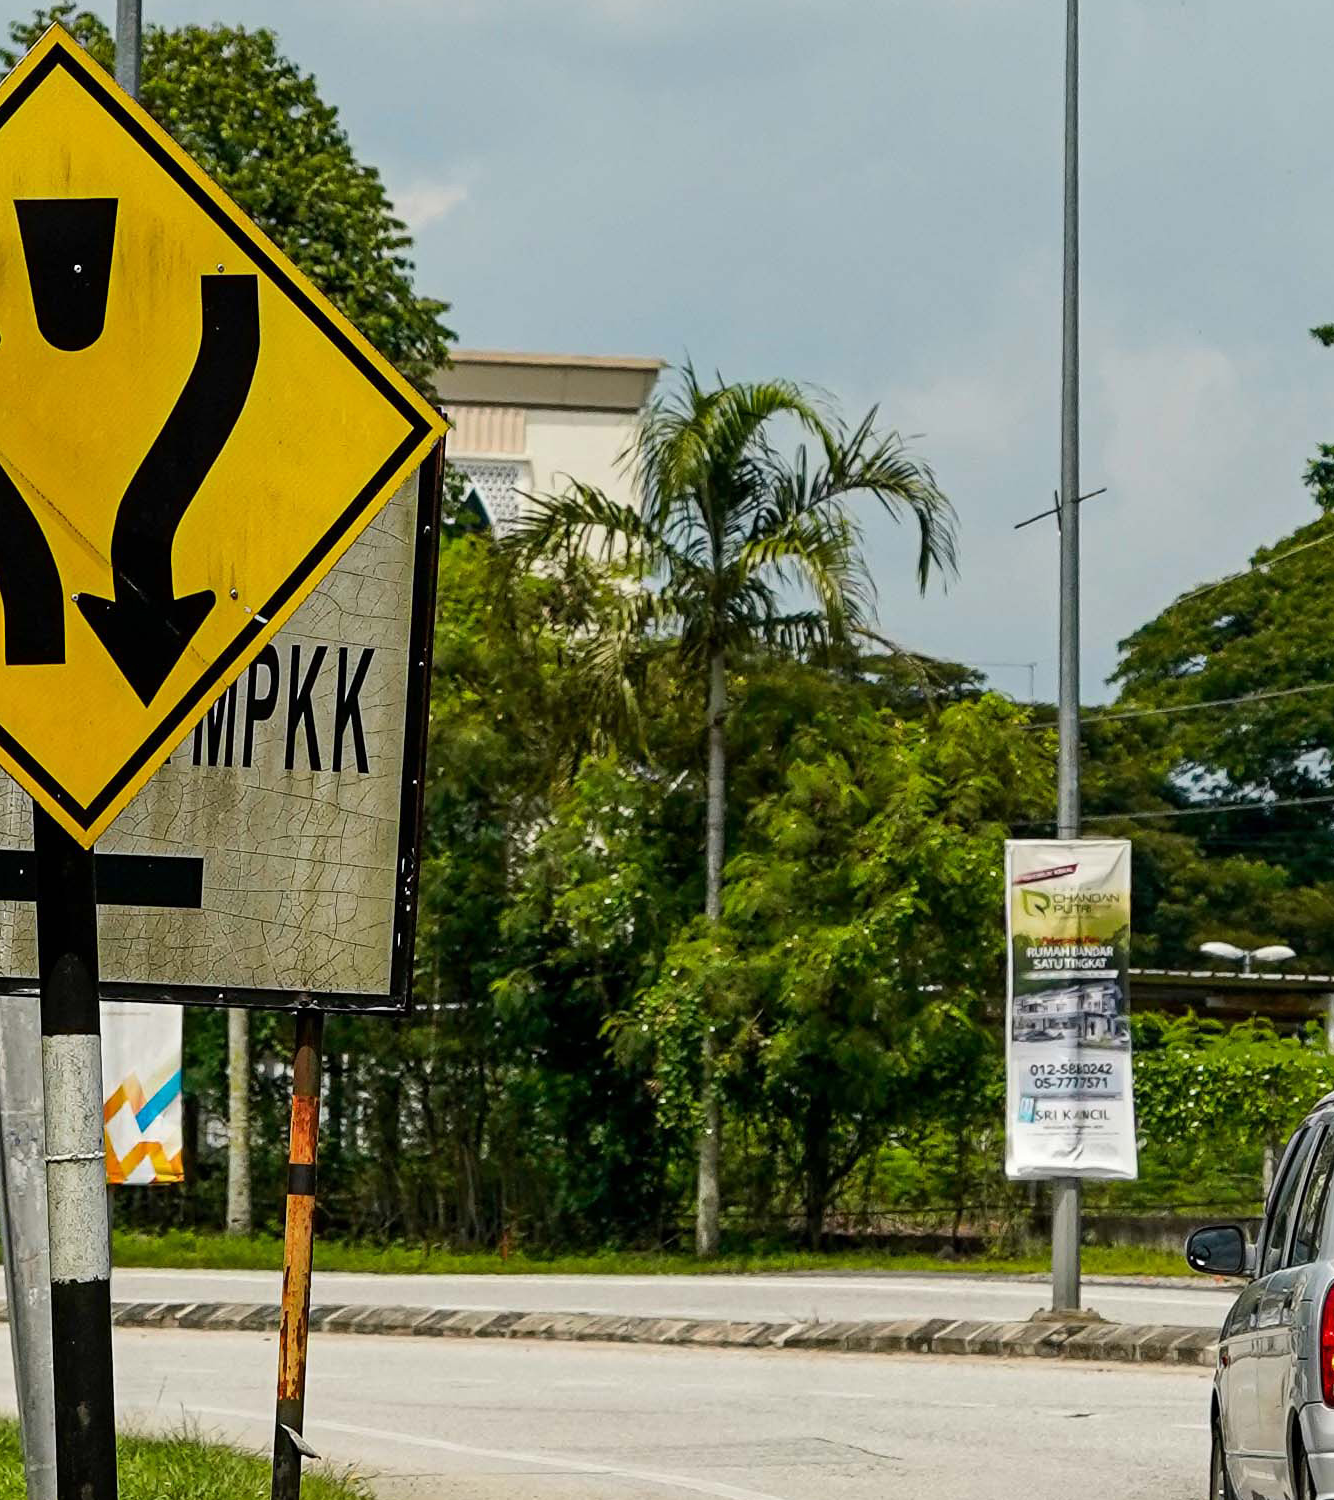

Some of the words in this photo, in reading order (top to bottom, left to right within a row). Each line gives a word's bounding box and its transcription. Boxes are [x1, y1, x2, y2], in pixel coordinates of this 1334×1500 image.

[1053, 893, 1120, 903] CHANDAN
[1026, 946, 1070, 958] RUMAH
[1033, 958, 1065, 970] SATU
[1066, 957, 1108, 969] TINGKAT
[1034, 1077, 1108, 1089] 05-7777571
[1035, 1110, 1057, 1121] SRI
[1063, 1109, 1110, 1121] KANCIL
